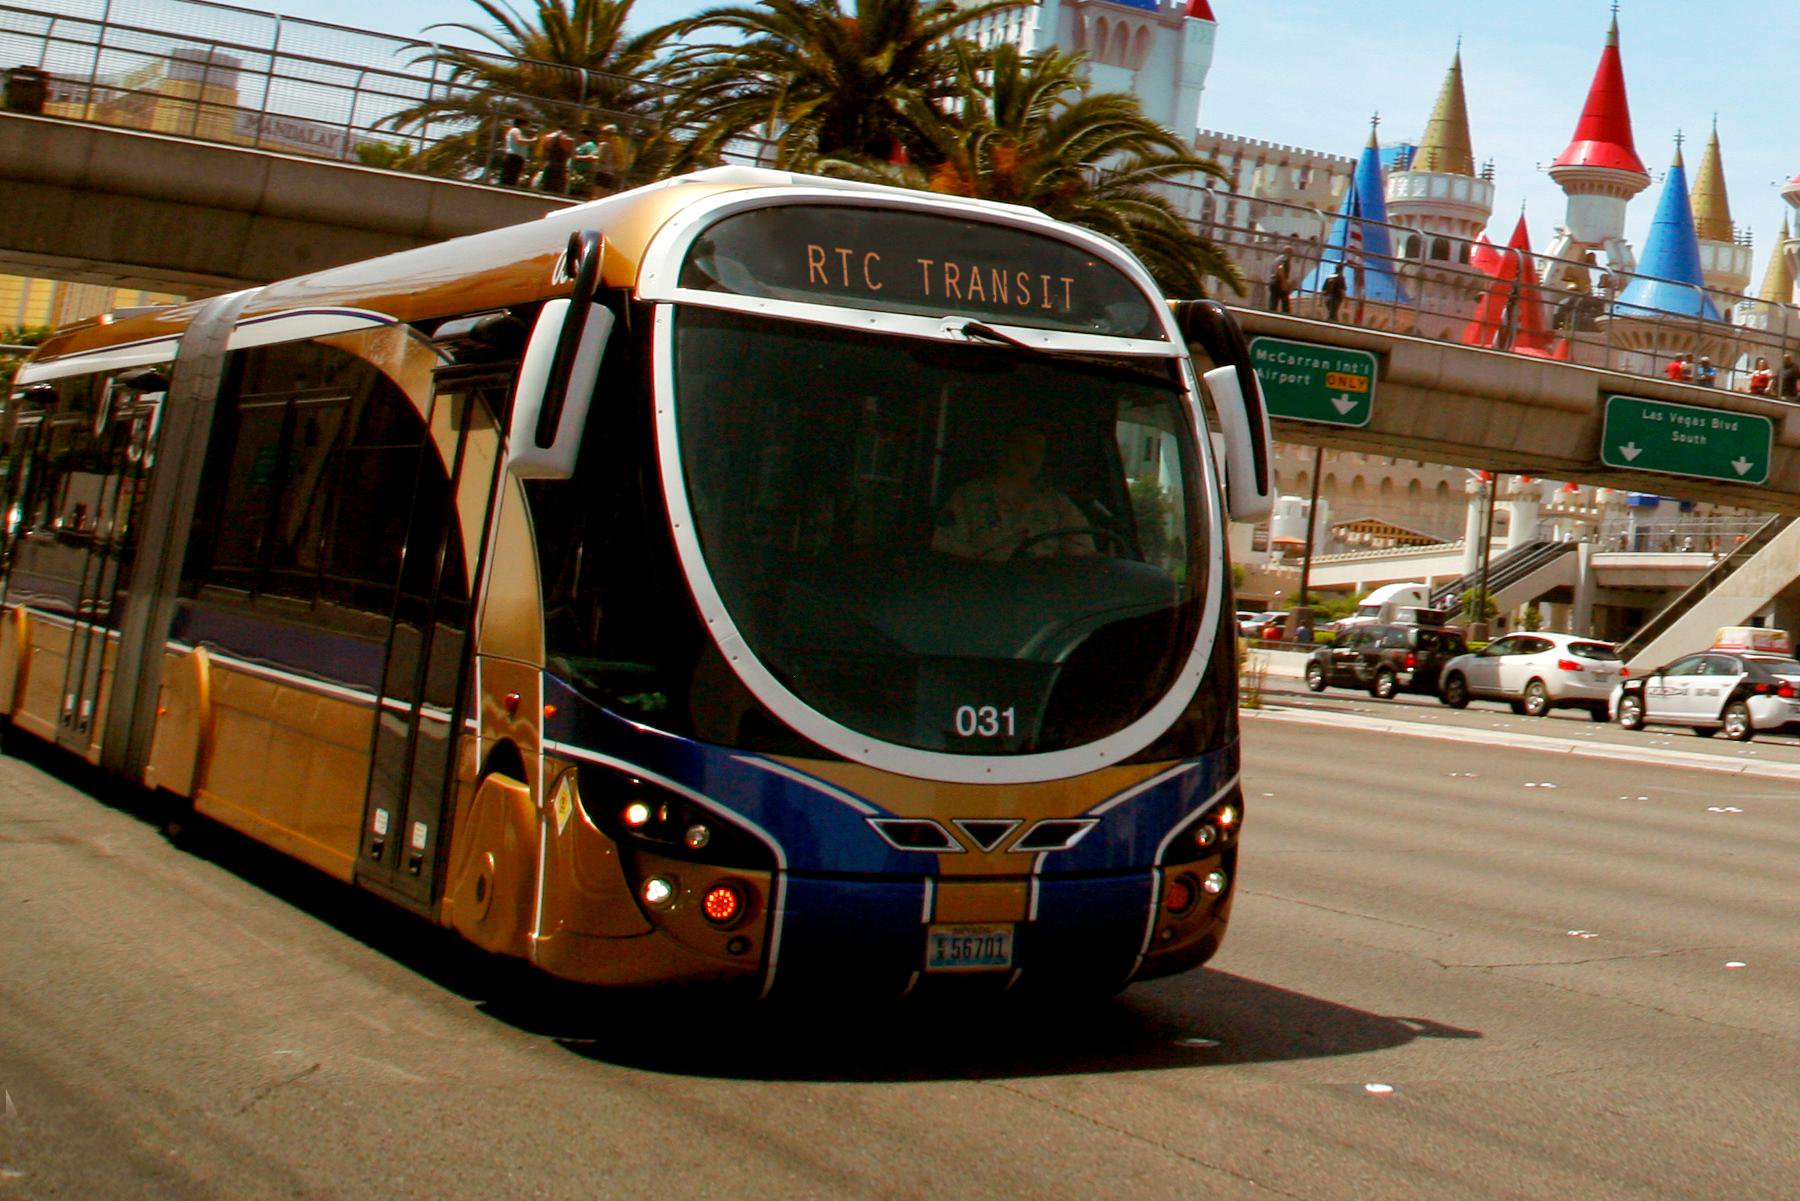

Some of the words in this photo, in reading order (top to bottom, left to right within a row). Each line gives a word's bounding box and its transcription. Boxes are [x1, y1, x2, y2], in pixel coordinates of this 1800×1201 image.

[807, 244, 883, 292] RTC
[917, 258, 1075, 312] TRANSIT
[1255, 348, 1330, 370] McCarran
[1336, 360, 1369, 375] Int'l
[1257, 367, 1310, 385] Airport
[1326, 373, 1366, 390] ONLY
[1642, 408, 1663, 421] Las
[1669, 412, 1706, 428] Vegas
[1711, 417, 1739, 431] Blvd
[1671, 430, 1707, 445] South
[956, 705, 1015, 736] 031
